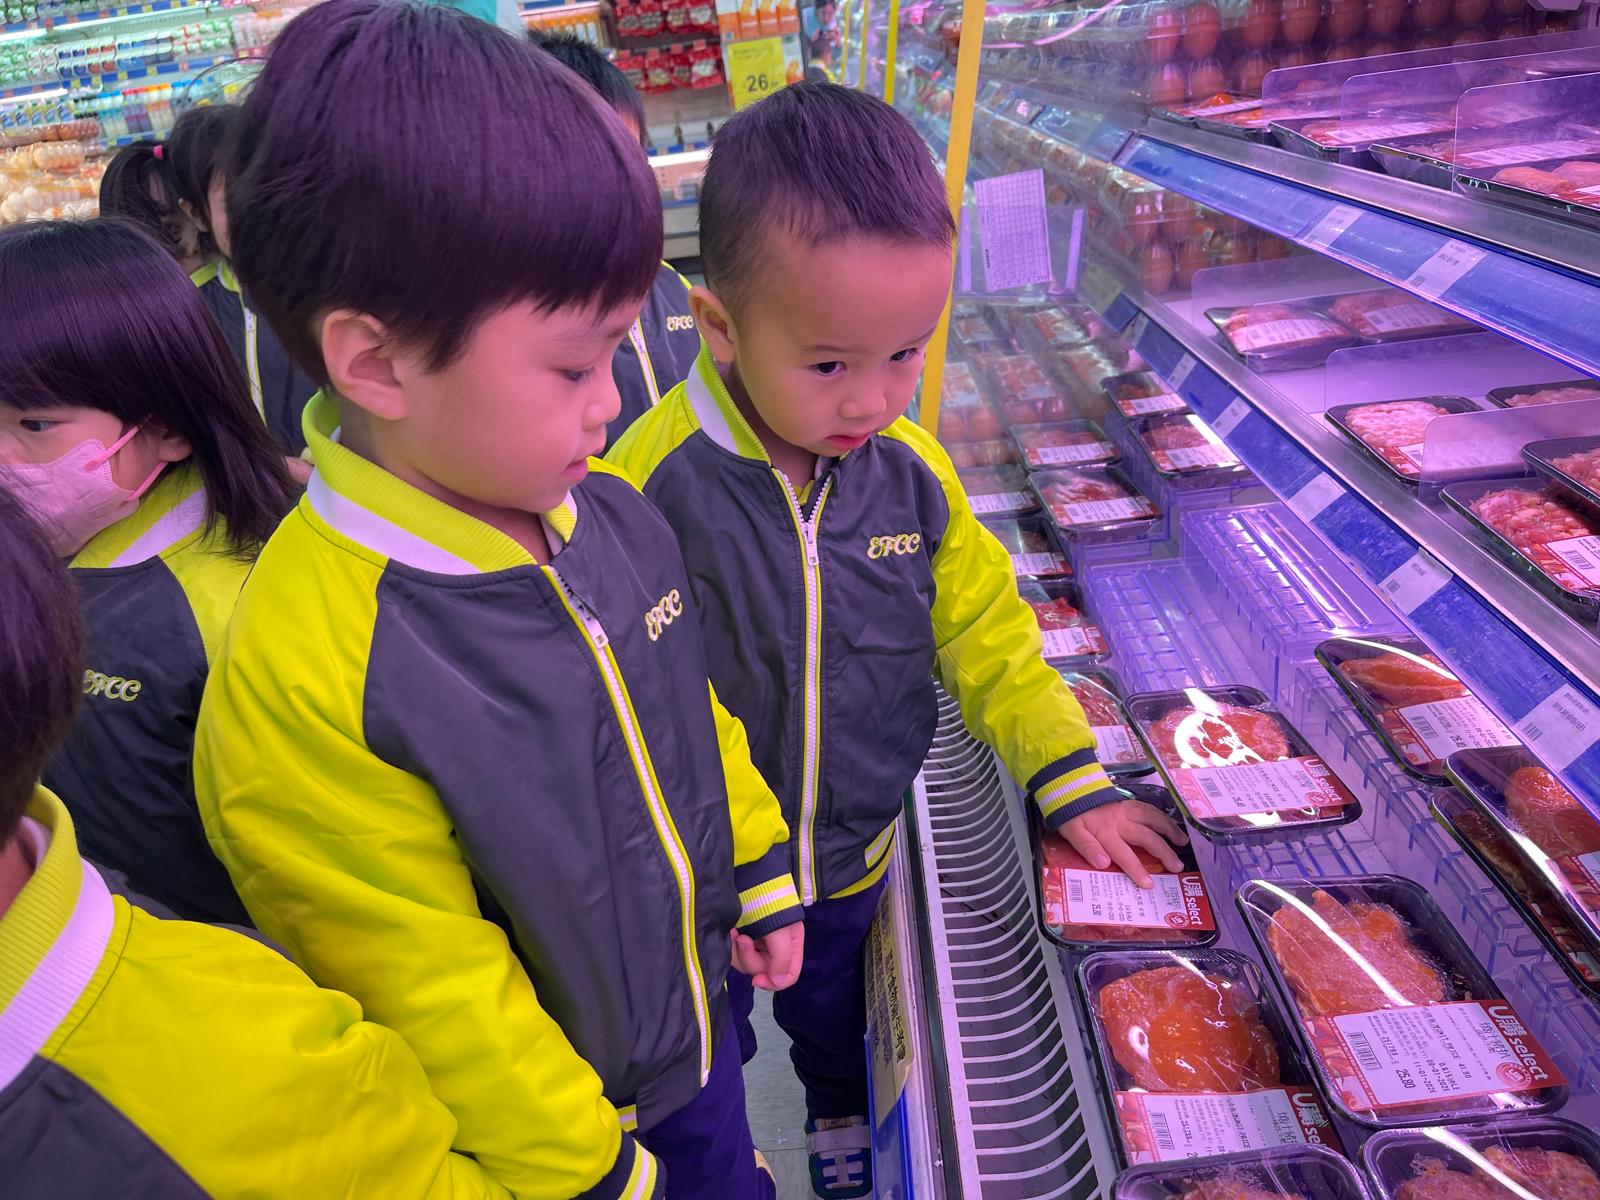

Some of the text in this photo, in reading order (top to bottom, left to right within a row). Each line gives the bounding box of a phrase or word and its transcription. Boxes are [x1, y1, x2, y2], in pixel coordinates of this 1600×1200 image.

[746, 74, 769, 93] 26
[866, 532, 921, 560] EFCC
[644, 588, 683, 642] EFCC
[1315, 776, 1343, 802] select
[1185, 897, 1203, 926] select
[1488, 1005, 1549, 1081] U購 select
[1395, 1068, 1416, 1089] 25.80
